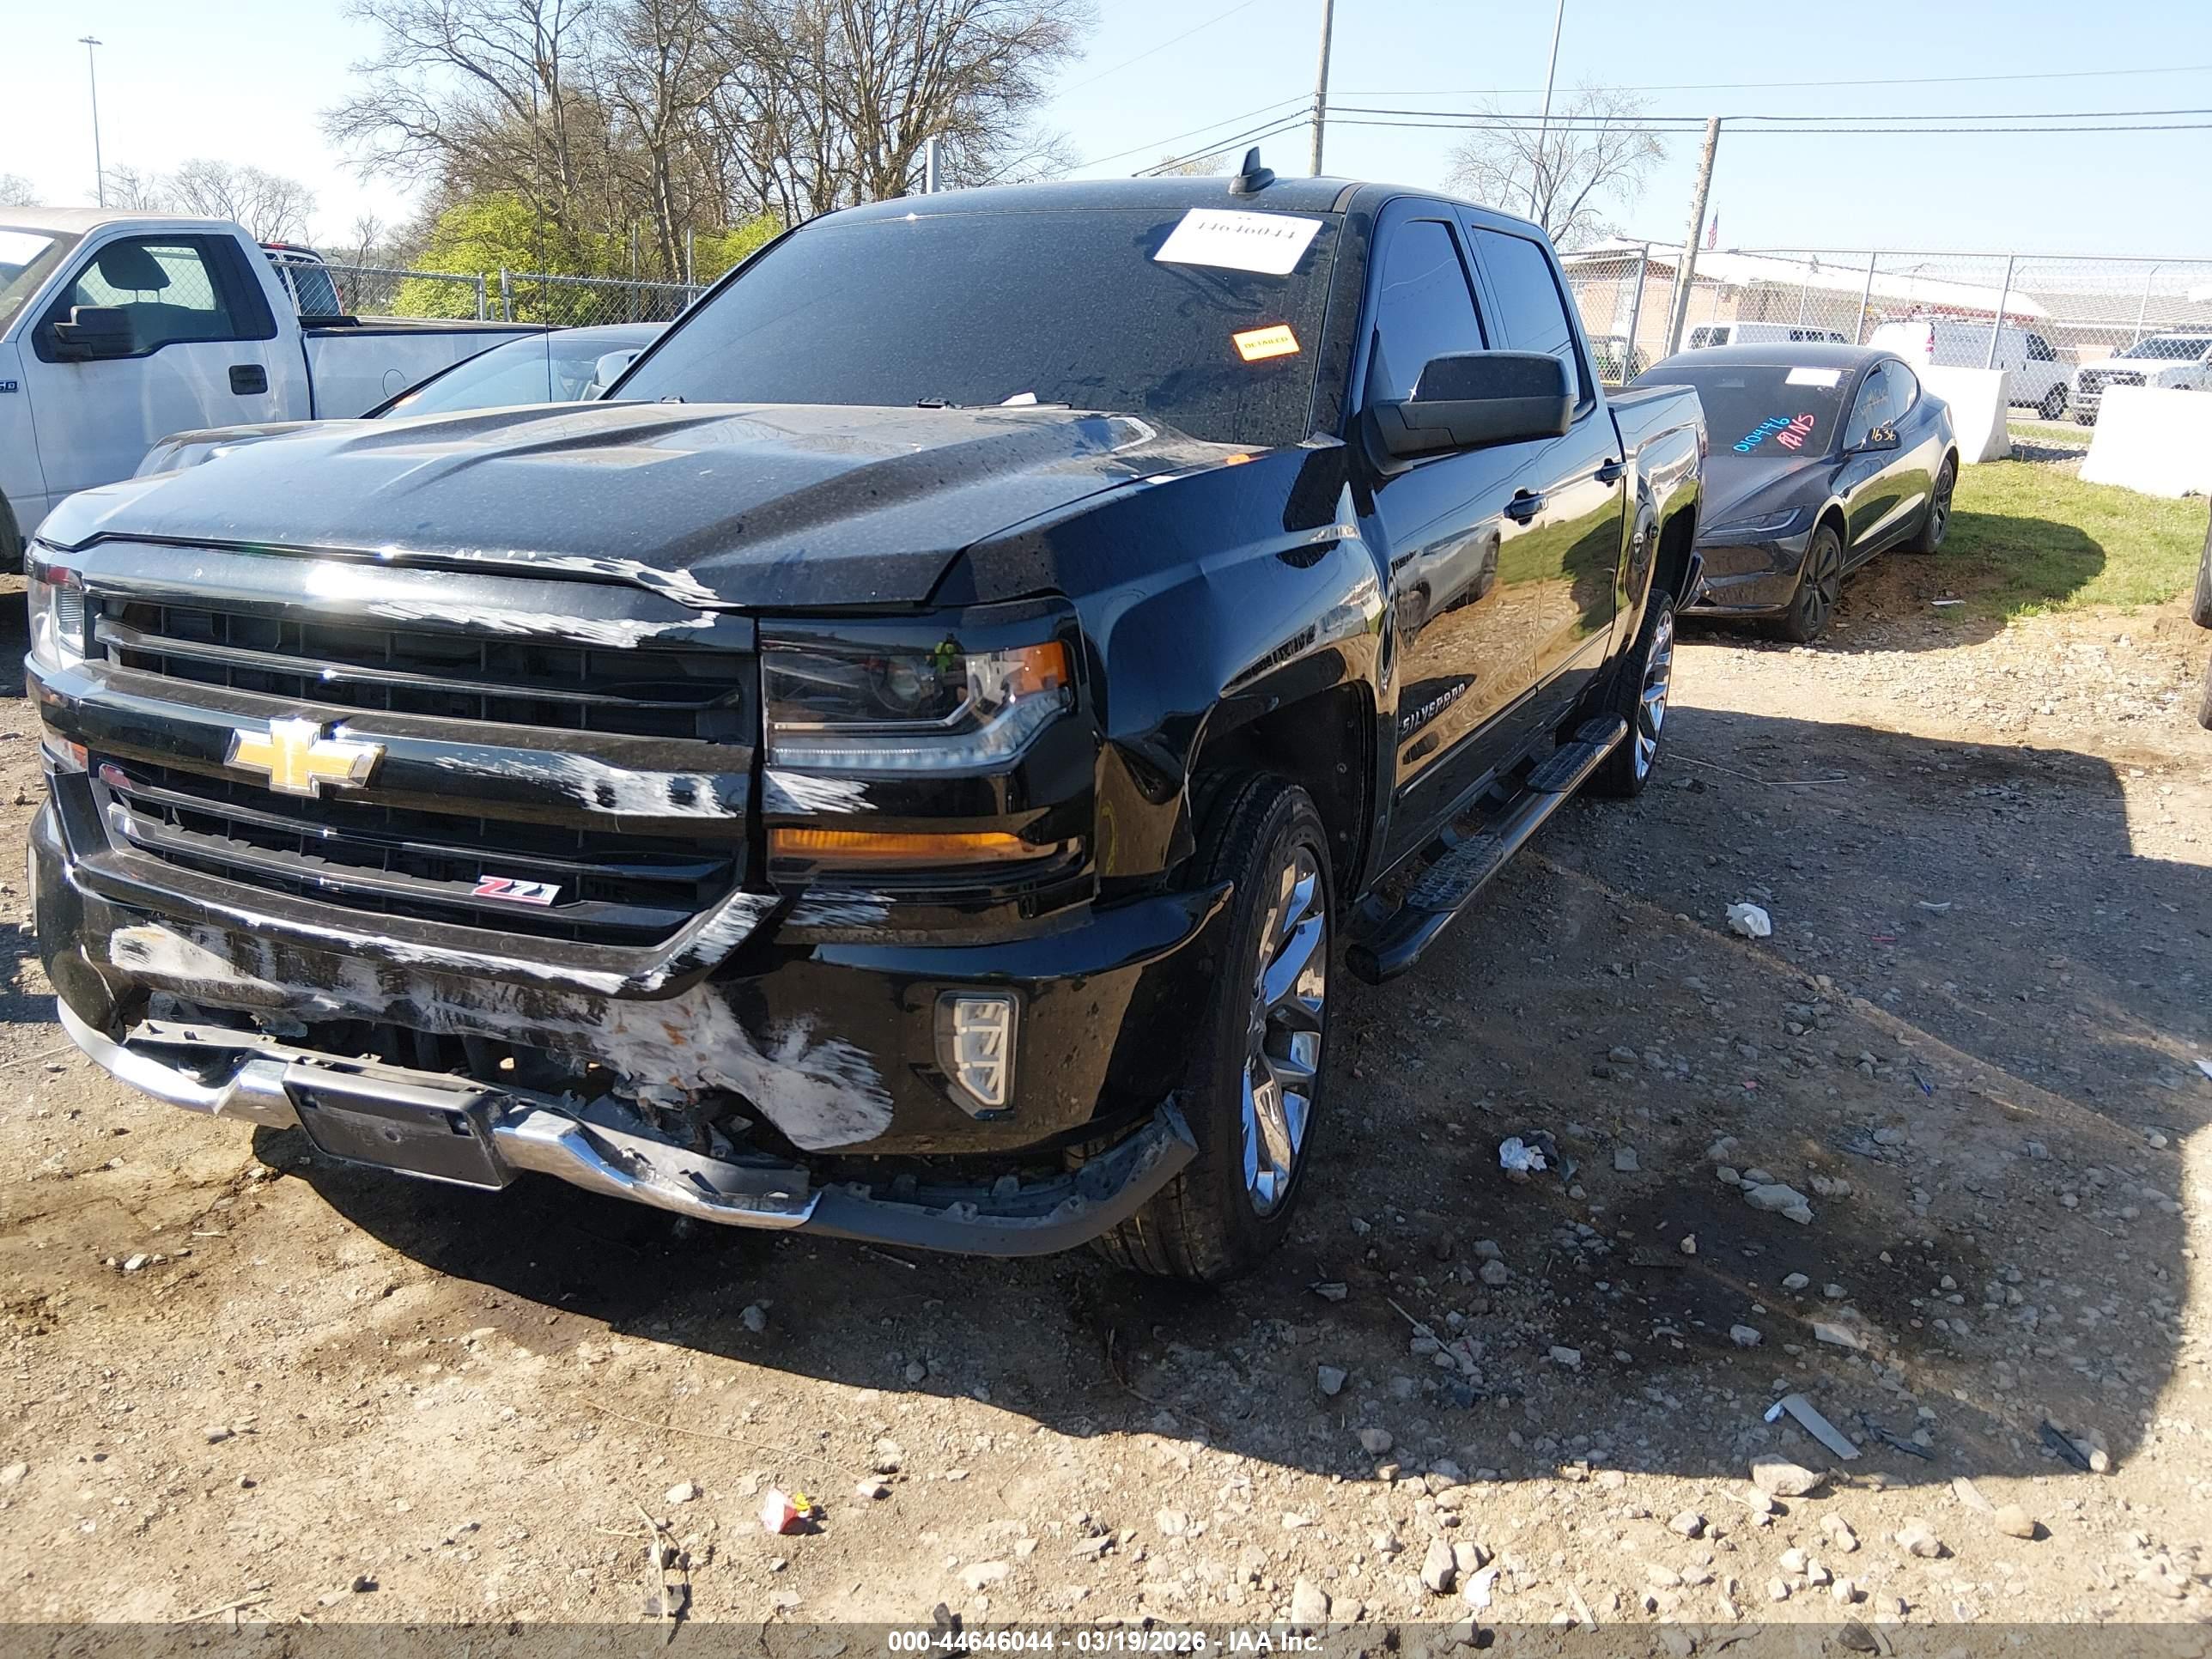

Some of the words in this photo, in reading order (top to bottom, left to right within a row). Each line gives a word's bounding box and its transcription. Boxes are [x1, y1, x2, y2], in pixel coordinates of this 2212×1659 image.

[1733, 417, 1790, 452] 010446
[1870, 426, 1897, 442] 1636
[1401, 683, 1465, 735] SILVERADO
[473, 874, 562, 907] Z71
